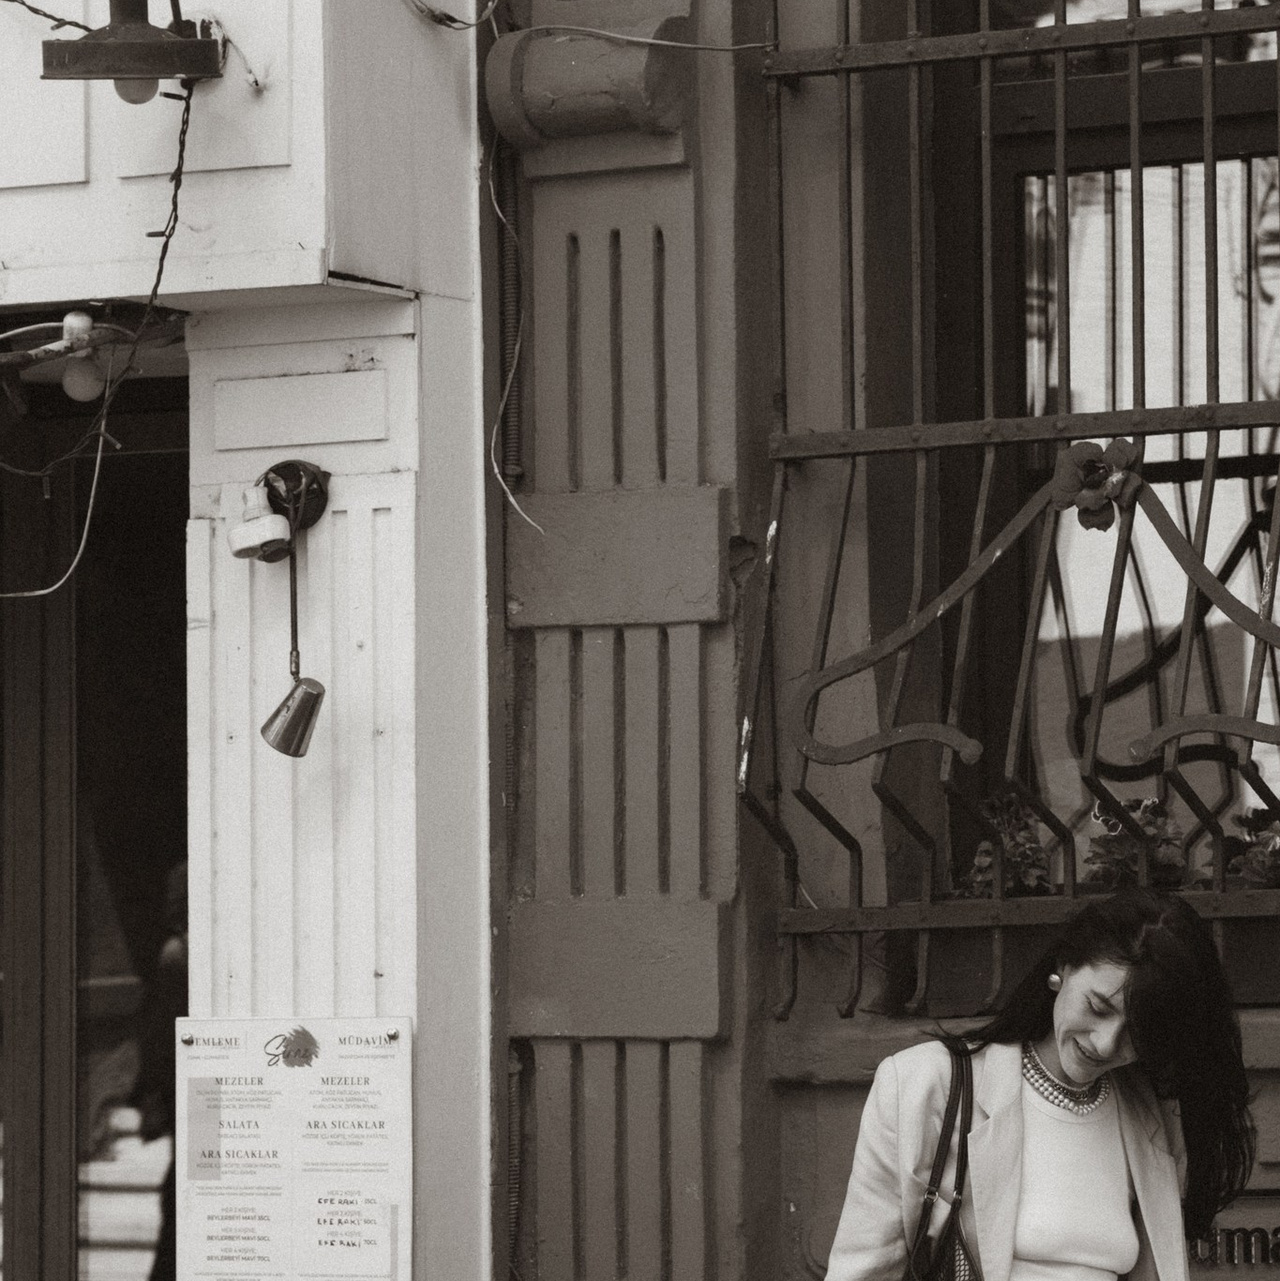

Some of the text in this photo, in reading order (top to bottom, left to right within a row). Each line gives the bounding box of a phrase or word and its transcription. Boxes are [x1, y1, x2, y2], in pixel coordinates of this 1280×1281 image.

[193, 1037, 240, 1047] EMLEME
[215, 1077, 264, 1086] MEZELER
[320, 1077, 370, 1086] MEZELER
[218, 1120, 260, 1129] SALATA
[306, 1120, 386, 1130] ARA SICAKLAR
[201, 1150, 278, 1159] ARA SICAKLAR
